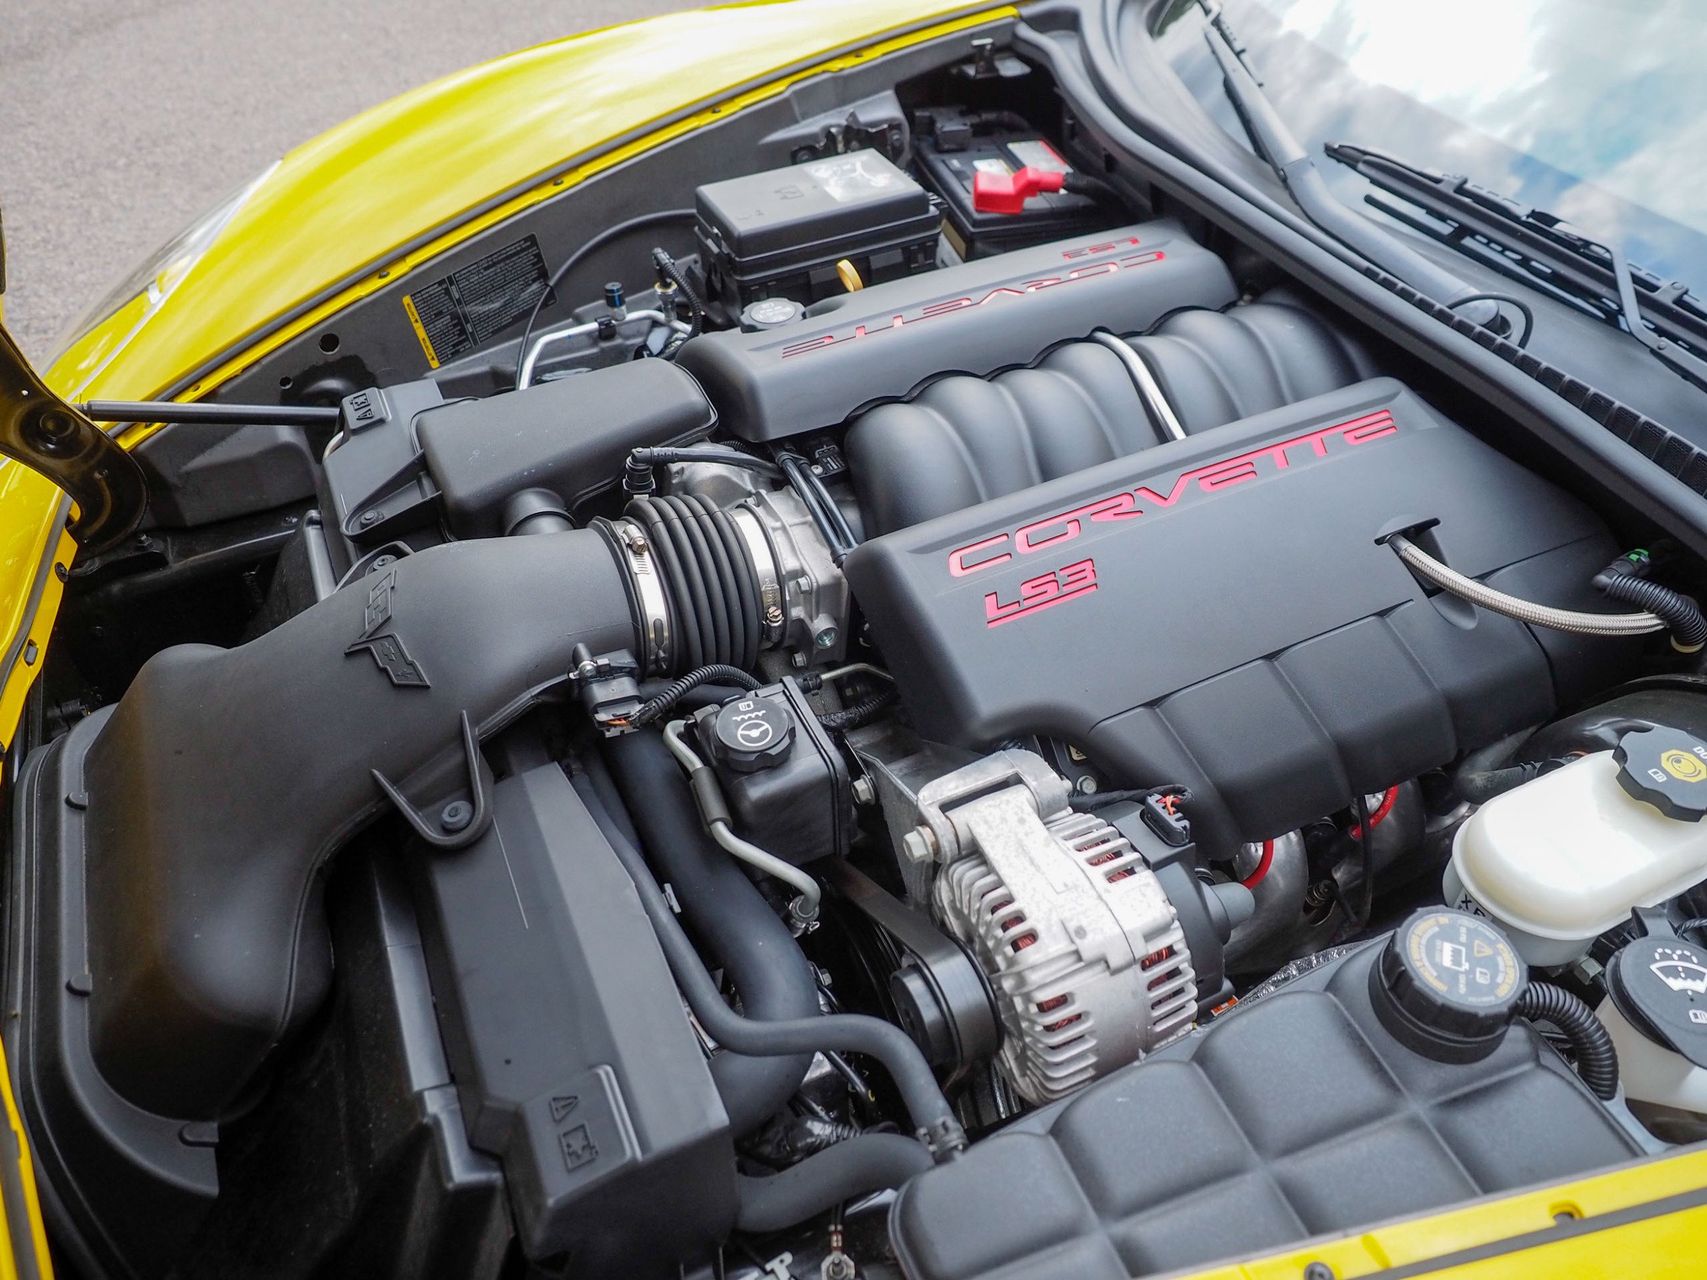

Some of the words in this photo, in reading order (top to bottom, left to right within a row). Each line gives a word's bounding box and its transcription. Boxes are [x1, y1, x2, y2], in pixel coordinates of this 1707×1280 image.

[782, 251, 1167, 357] CORVETTE
[949, 410, 1397, 577] CORVETTE
[983, 558, 1099, 628] LS3
